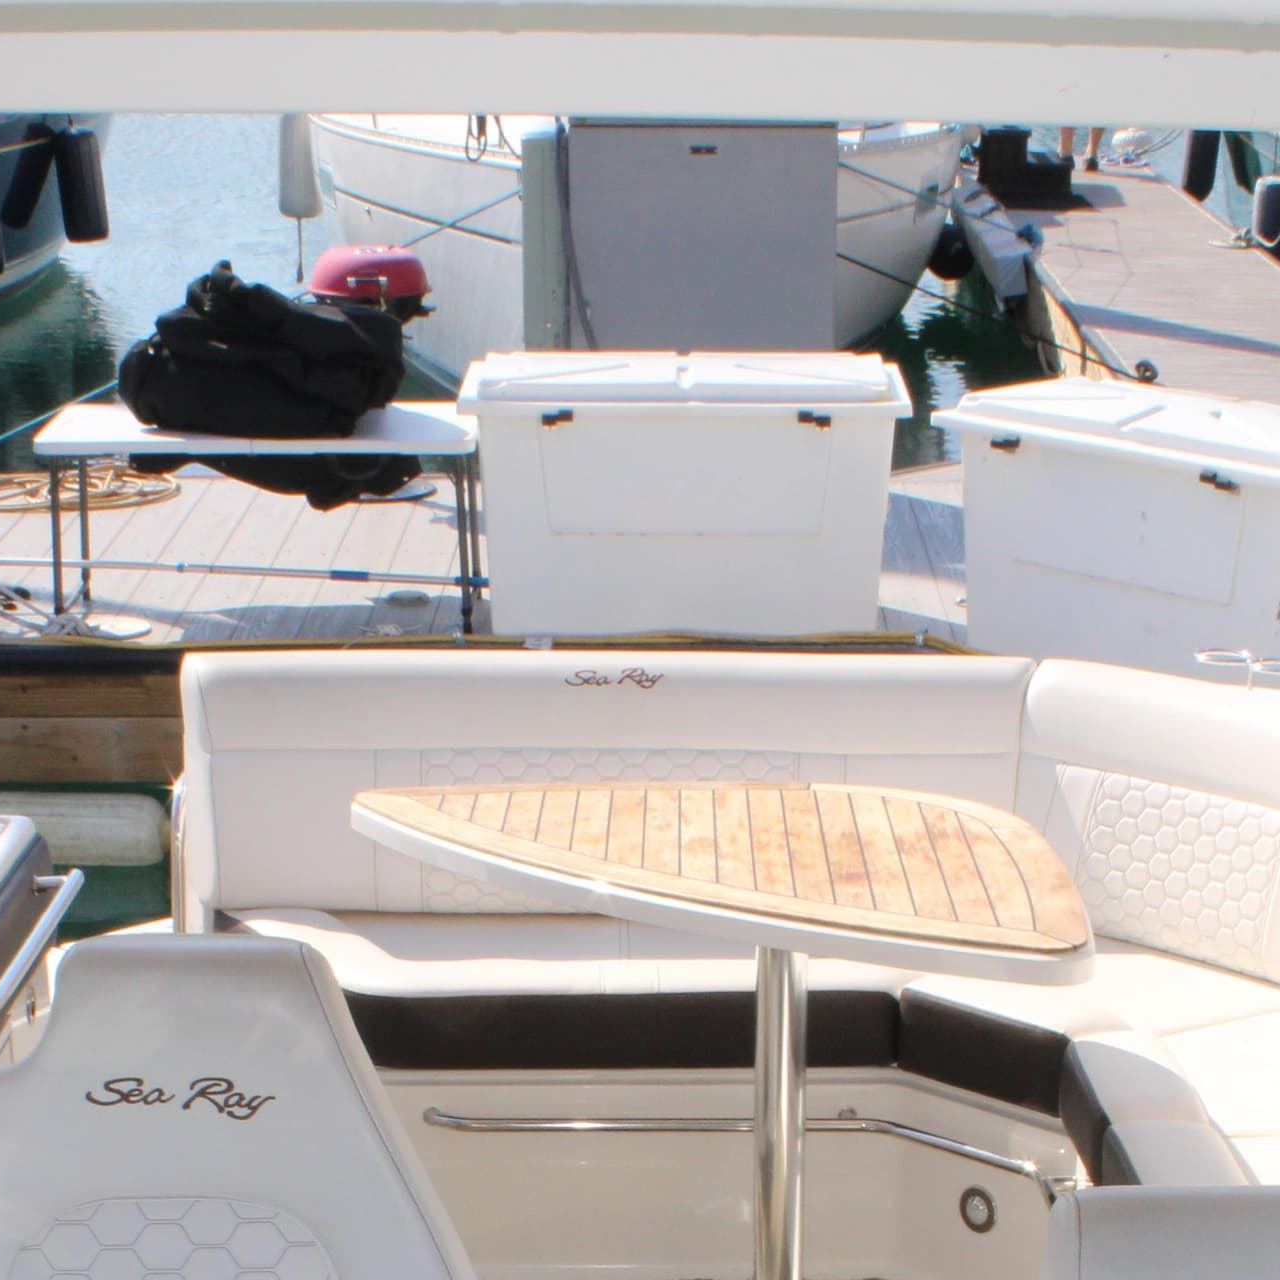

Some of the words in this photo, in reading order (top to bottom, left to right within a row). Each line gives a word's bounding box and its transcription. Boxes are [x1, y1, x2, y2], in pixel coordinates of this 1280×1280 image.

[564, 669, 611, 687] Sea
[617, 667, 664, 689] Ray
[85, 1077, 176, 1107] Sea
[181, 1077, 276, 1120] Ray
